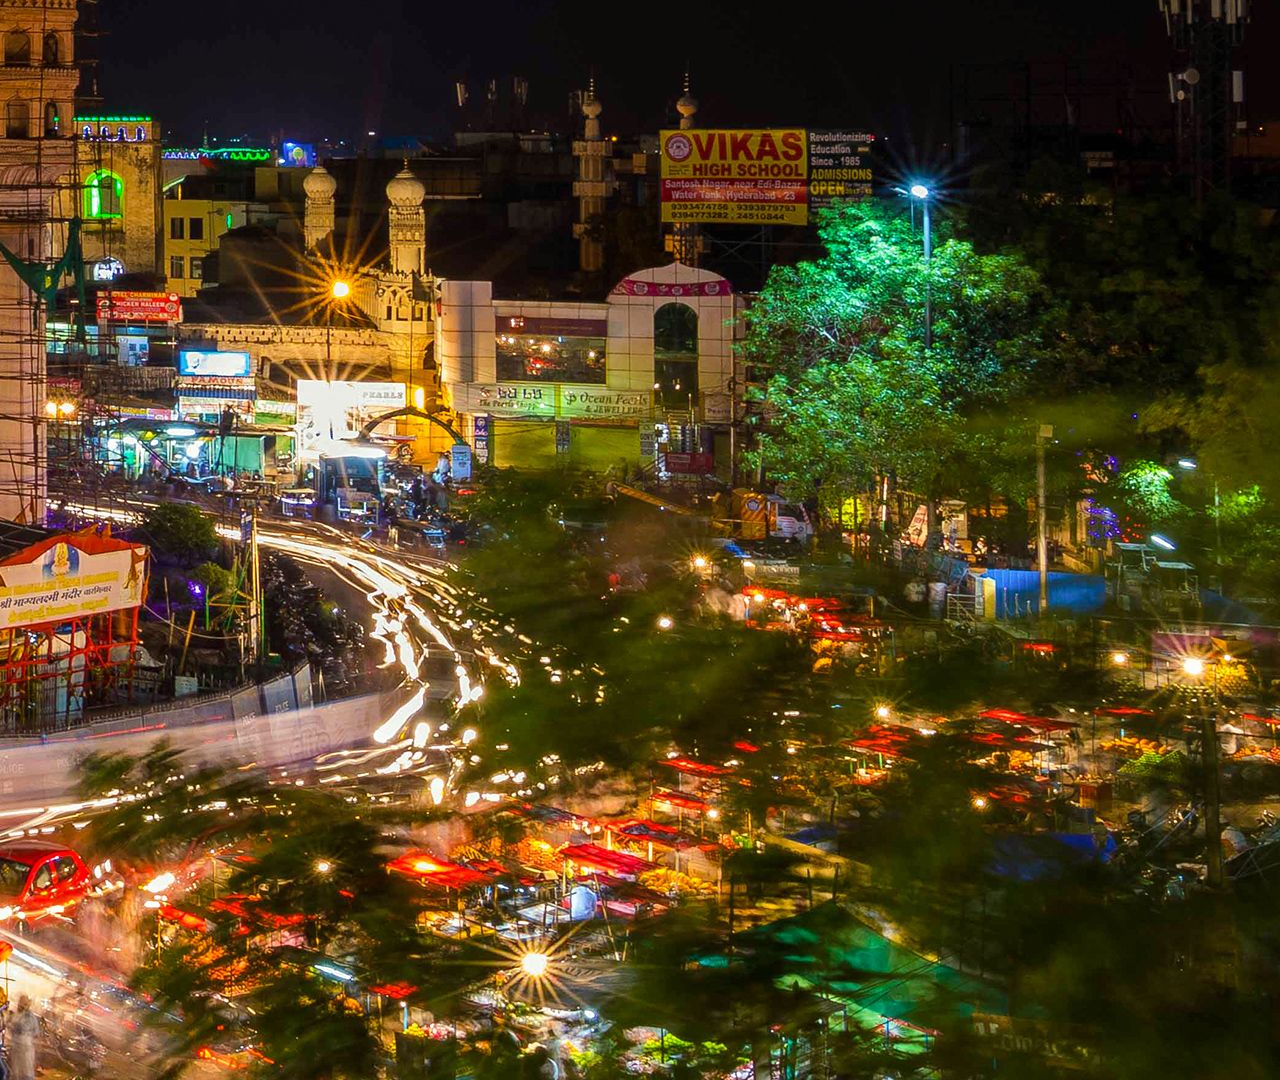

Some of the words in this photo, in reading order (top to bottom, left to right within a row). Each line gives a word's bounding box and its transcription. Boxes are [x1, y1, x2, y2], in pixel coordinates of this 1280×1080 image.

[692, 133, 804, 161] VIKAS
[810, 144, 851, 154] Education
[811, 156, 834, 166] Since
[841, 156, 861, 166] 1985
[692, 164, 732, 176] HIGH
[737, 164, 804, 177] SCHOOL
[811, 168, 873, 180] ADMISSIONS
[665, 180, 701, 188] Santosh
[810, 181, 845, 195] OPEN
[671, 190, 697, 199] Water
[726, 190, 776, 200] Hyderabad
[784, 191, 796, 200] 23
[580, 392, 612, 404] Ocean
[615, 393, 649, 406] Pearls
[0, 597, 12, 610] श्री
